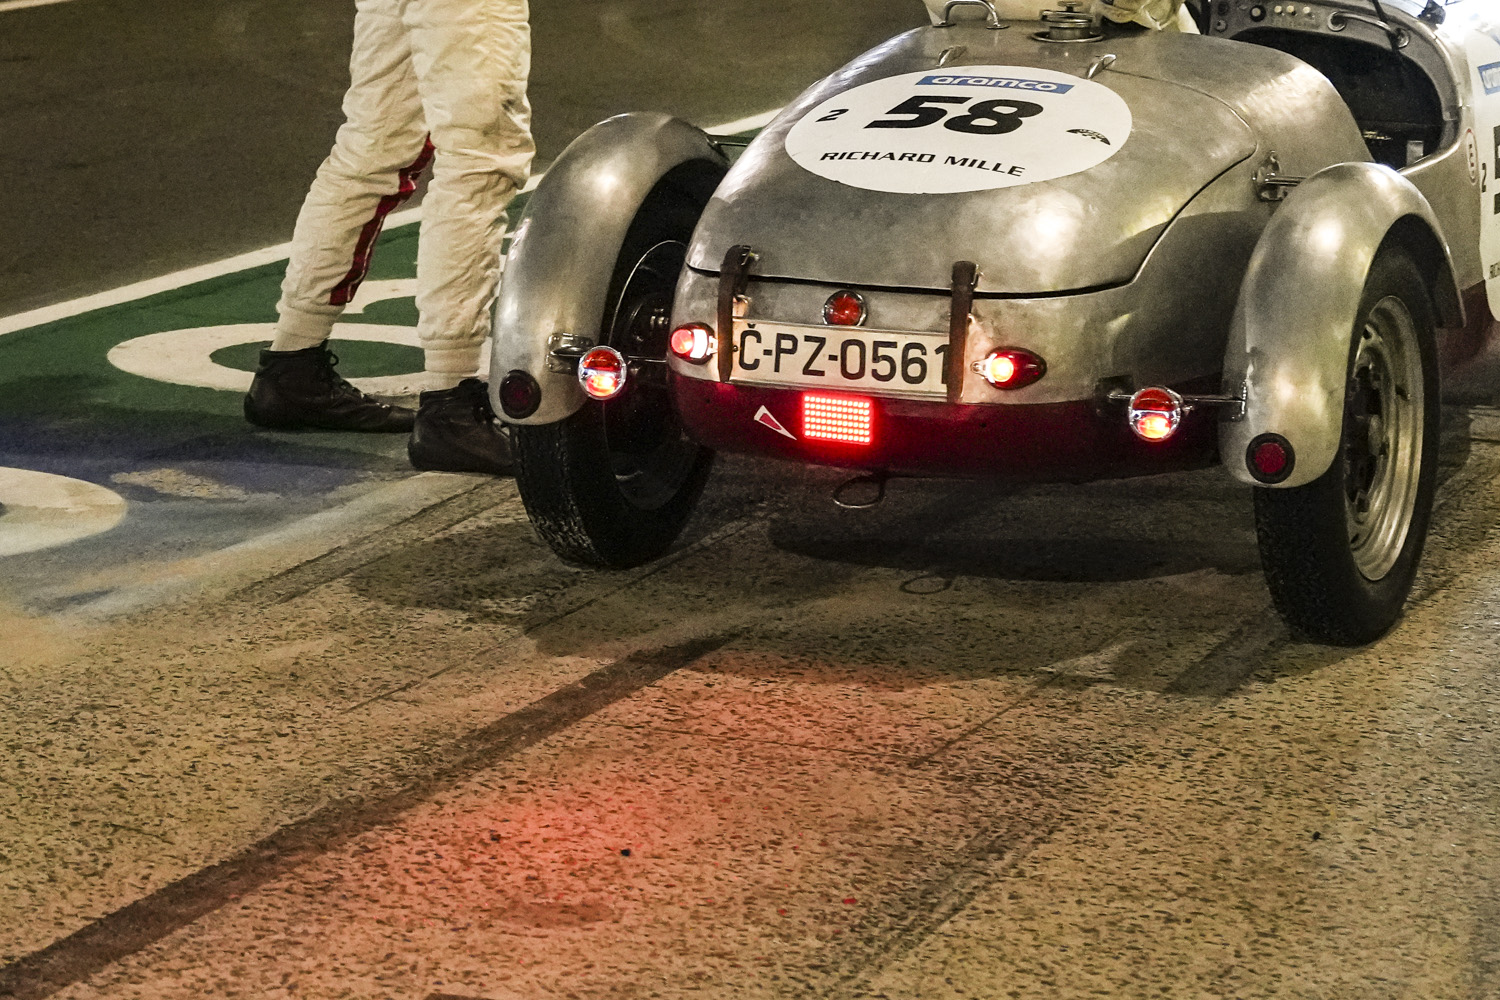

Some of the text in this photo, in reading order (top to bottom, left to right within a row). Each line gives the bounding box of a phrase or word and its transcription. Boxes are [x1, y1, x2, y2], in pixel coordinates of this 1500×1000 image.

[931, 74, 1058, 92] aramco
[815, 95, 1044, 135] 2 58
[820, 151, 1026, 177] RICHARD MILLE
[1481, 162, 1487, 193] 2
